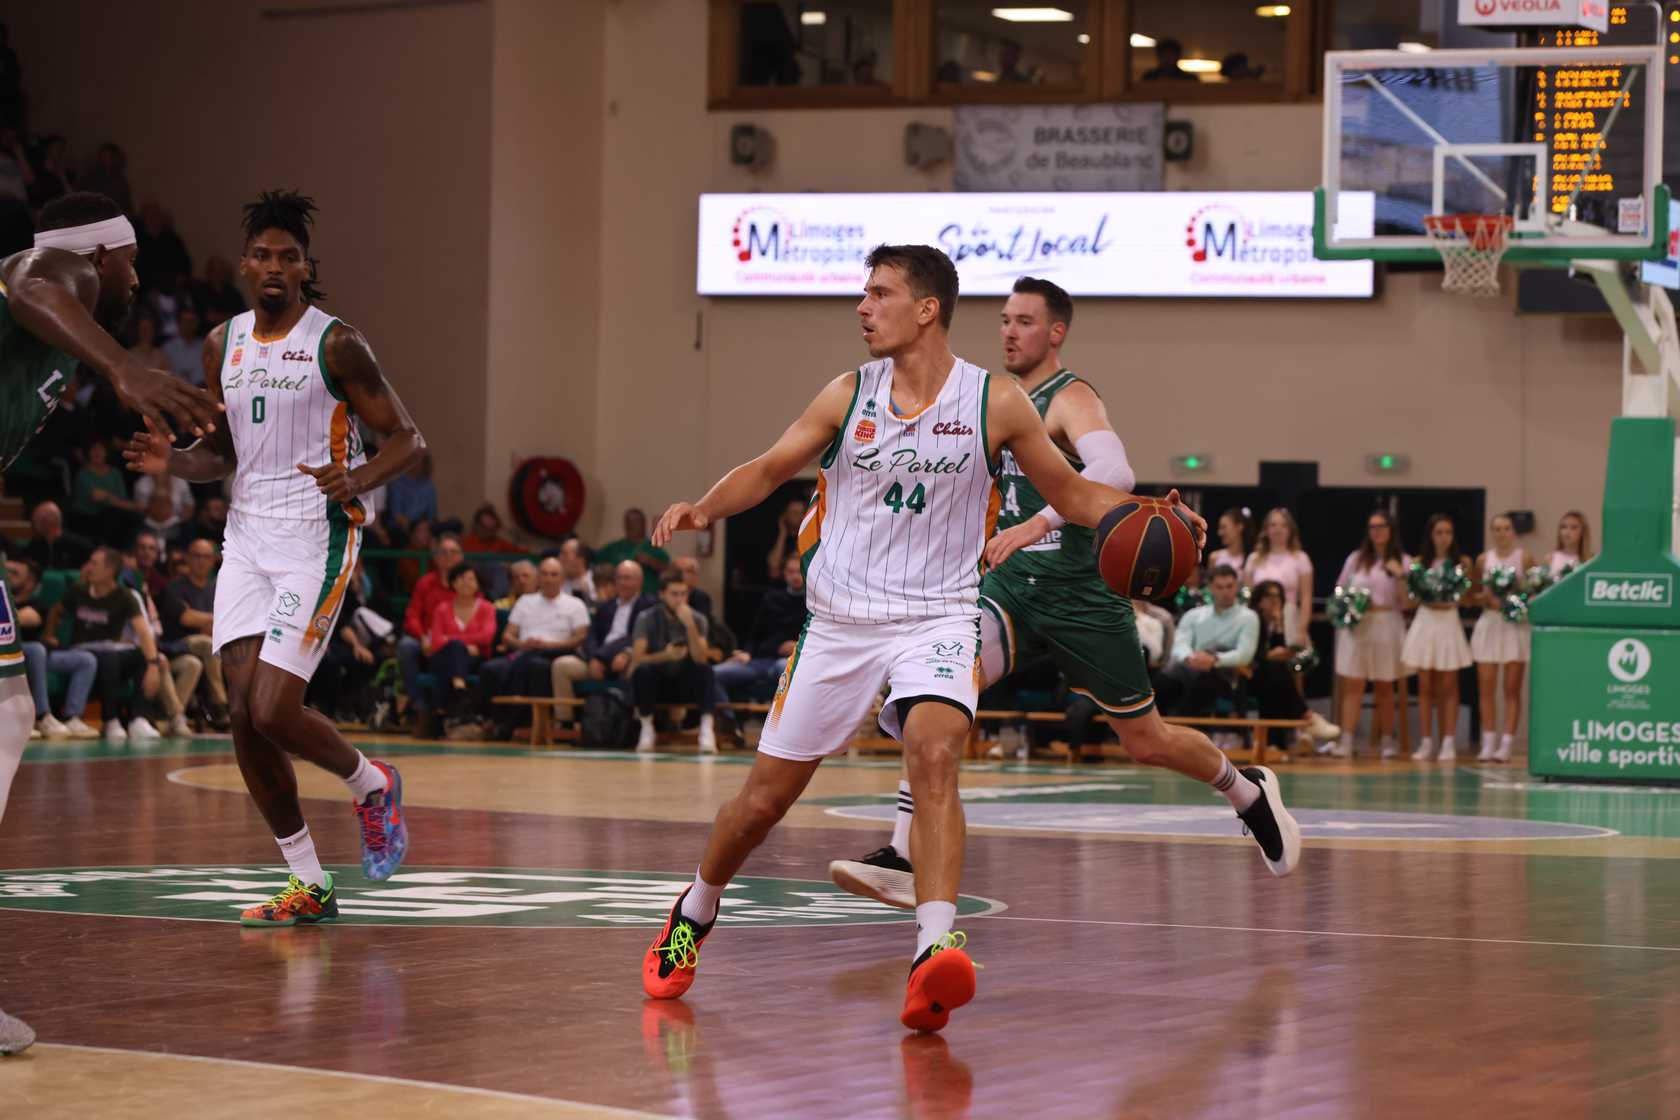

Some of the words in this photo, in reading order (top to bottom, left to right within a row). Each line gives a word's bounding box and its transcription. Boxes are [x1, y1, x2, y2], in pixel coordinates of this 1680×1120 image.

[1033, 126, 1149, 145] BRASSERIE
[1024, 152, 1049, 169] de
[790, 220, 864, 243] Limoges
[224, 369, 244, 391] Le
[248, 368, 308, 391] Portel
[252, 396, 265, 424] 0
[855, 430, 876, 440] KING
[853, 448, 884, 473] Le
[888, 448, 971, 475] Portel
[883, 482, 926, 514] 44
[1591, 579, 1665, 601] Betclic
[1556, 741, 1603, 764] ville
